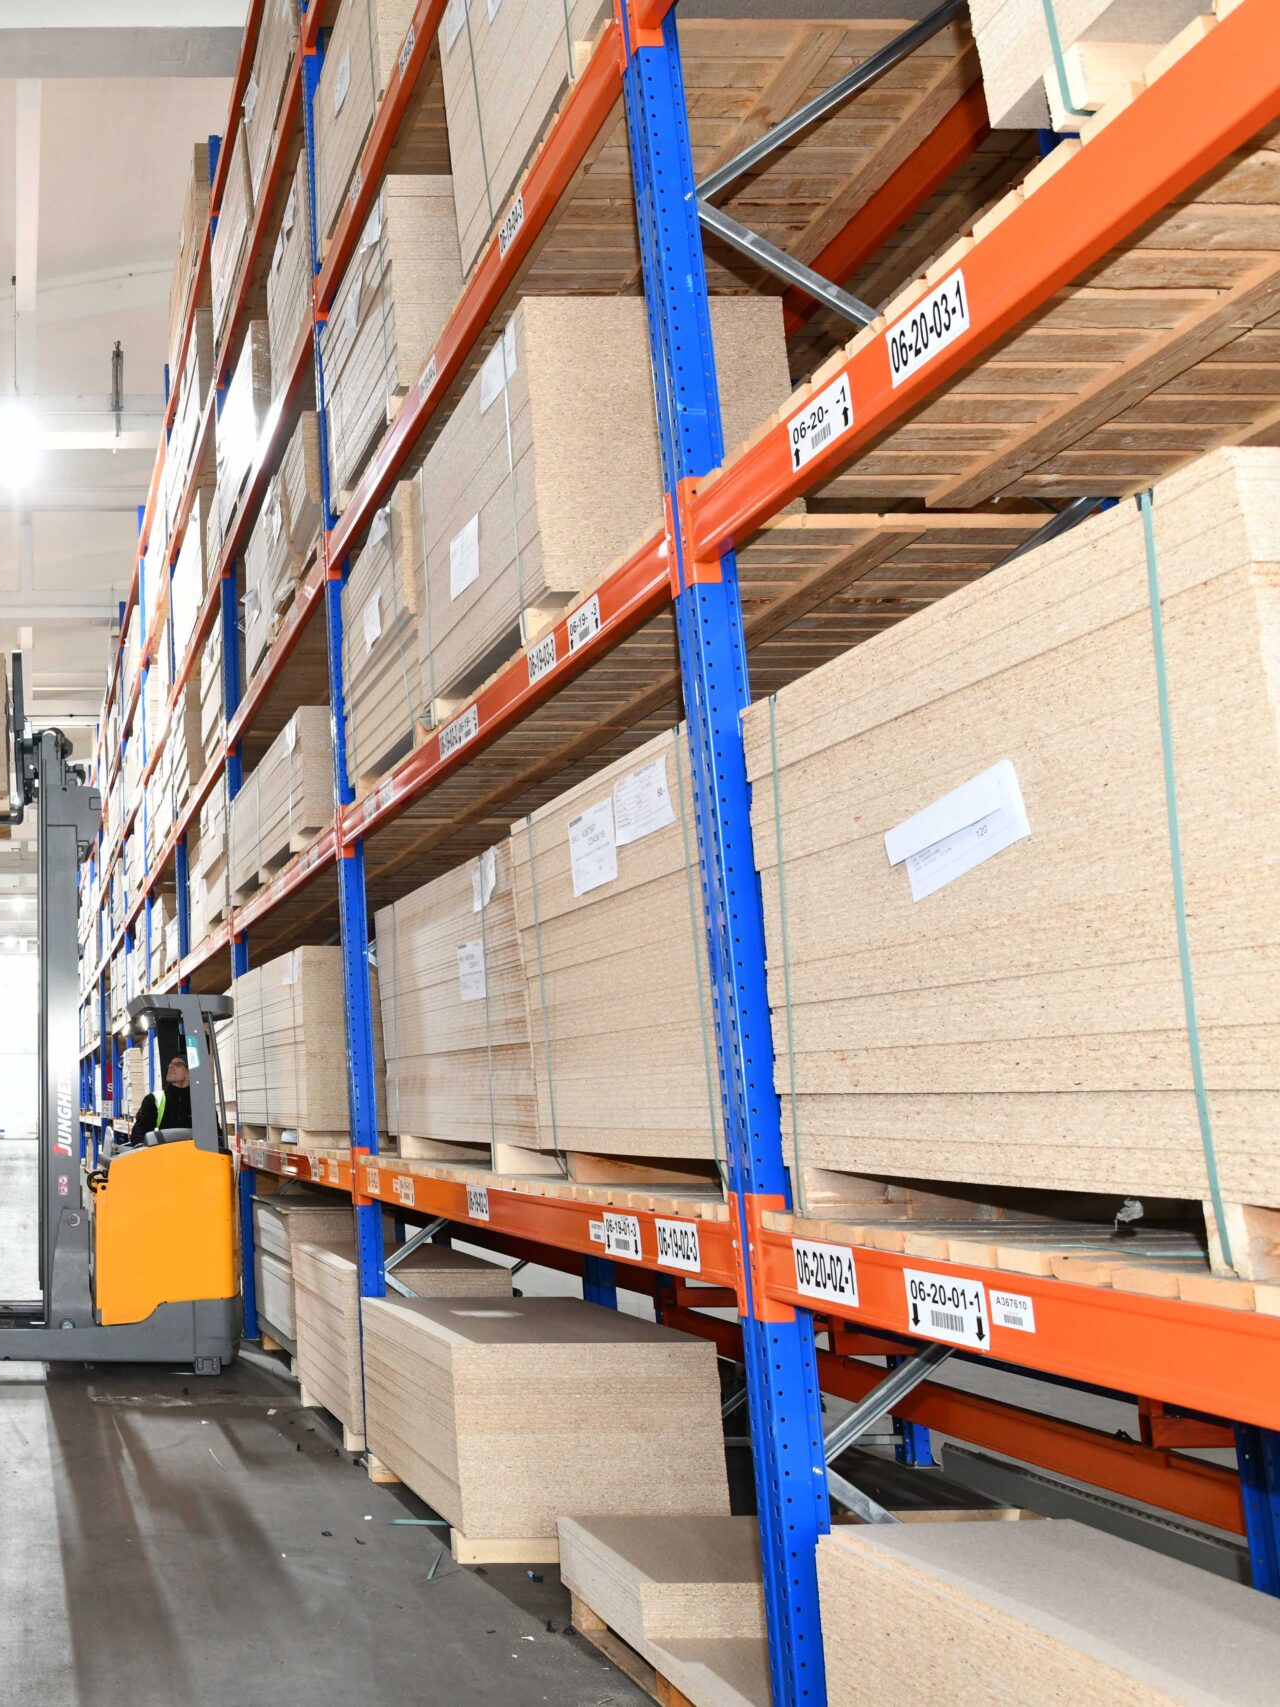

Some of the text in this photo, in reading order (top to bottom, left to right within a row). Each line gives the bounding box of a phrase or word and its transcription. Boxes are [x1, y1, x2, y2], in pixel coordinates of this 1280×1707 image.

[891, 280, 964, 373] 06-20-03-1
[793, 385, 847, 445] 06-20- -1
[606, 1219, 637, 1237] 06-19-01-3
[658, 1226, 698, 1262] 06-19-02-3
[796, 1248, 855, 1295] 06-20-02-1
[910, 1279, 981, 1313] 06-20-01-1
[996, 1296, 1027, 1310] A367610
